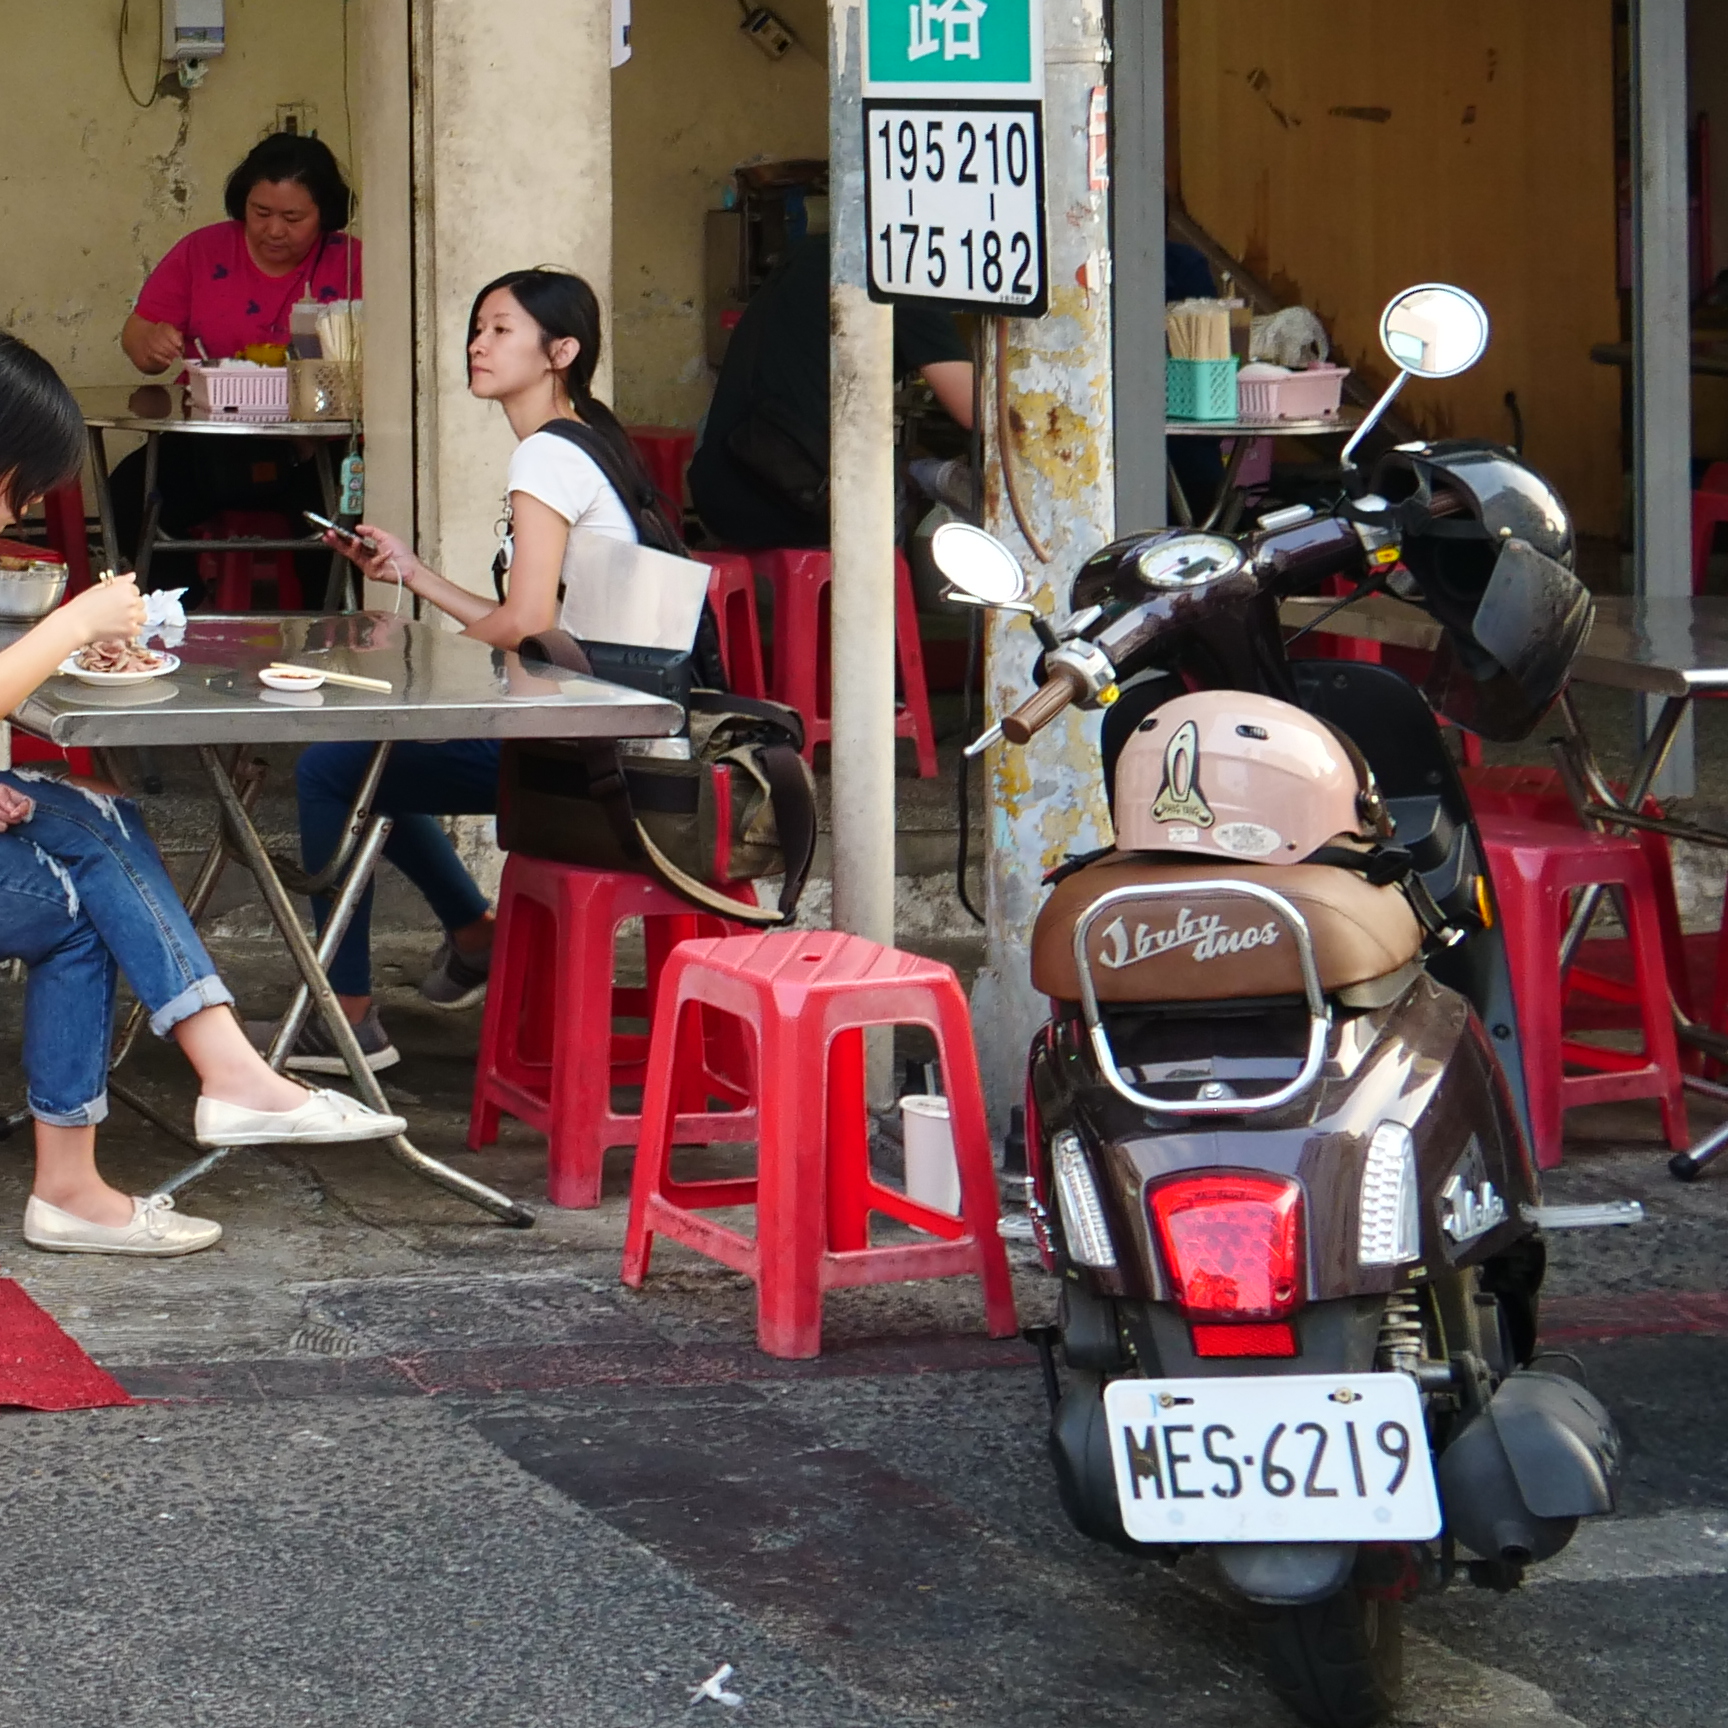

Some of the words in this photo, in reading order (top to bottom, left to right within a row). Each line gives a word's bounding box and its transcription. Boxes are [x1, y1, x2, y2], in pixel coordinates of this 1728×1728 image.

[878, 119, 944, 183] 195
[957, 121, 1028, 187] 210
[880, 223, 946, 288] 175
[960, 229, 1032, 295] 182
[1192, 921, 1280, 962] duos
